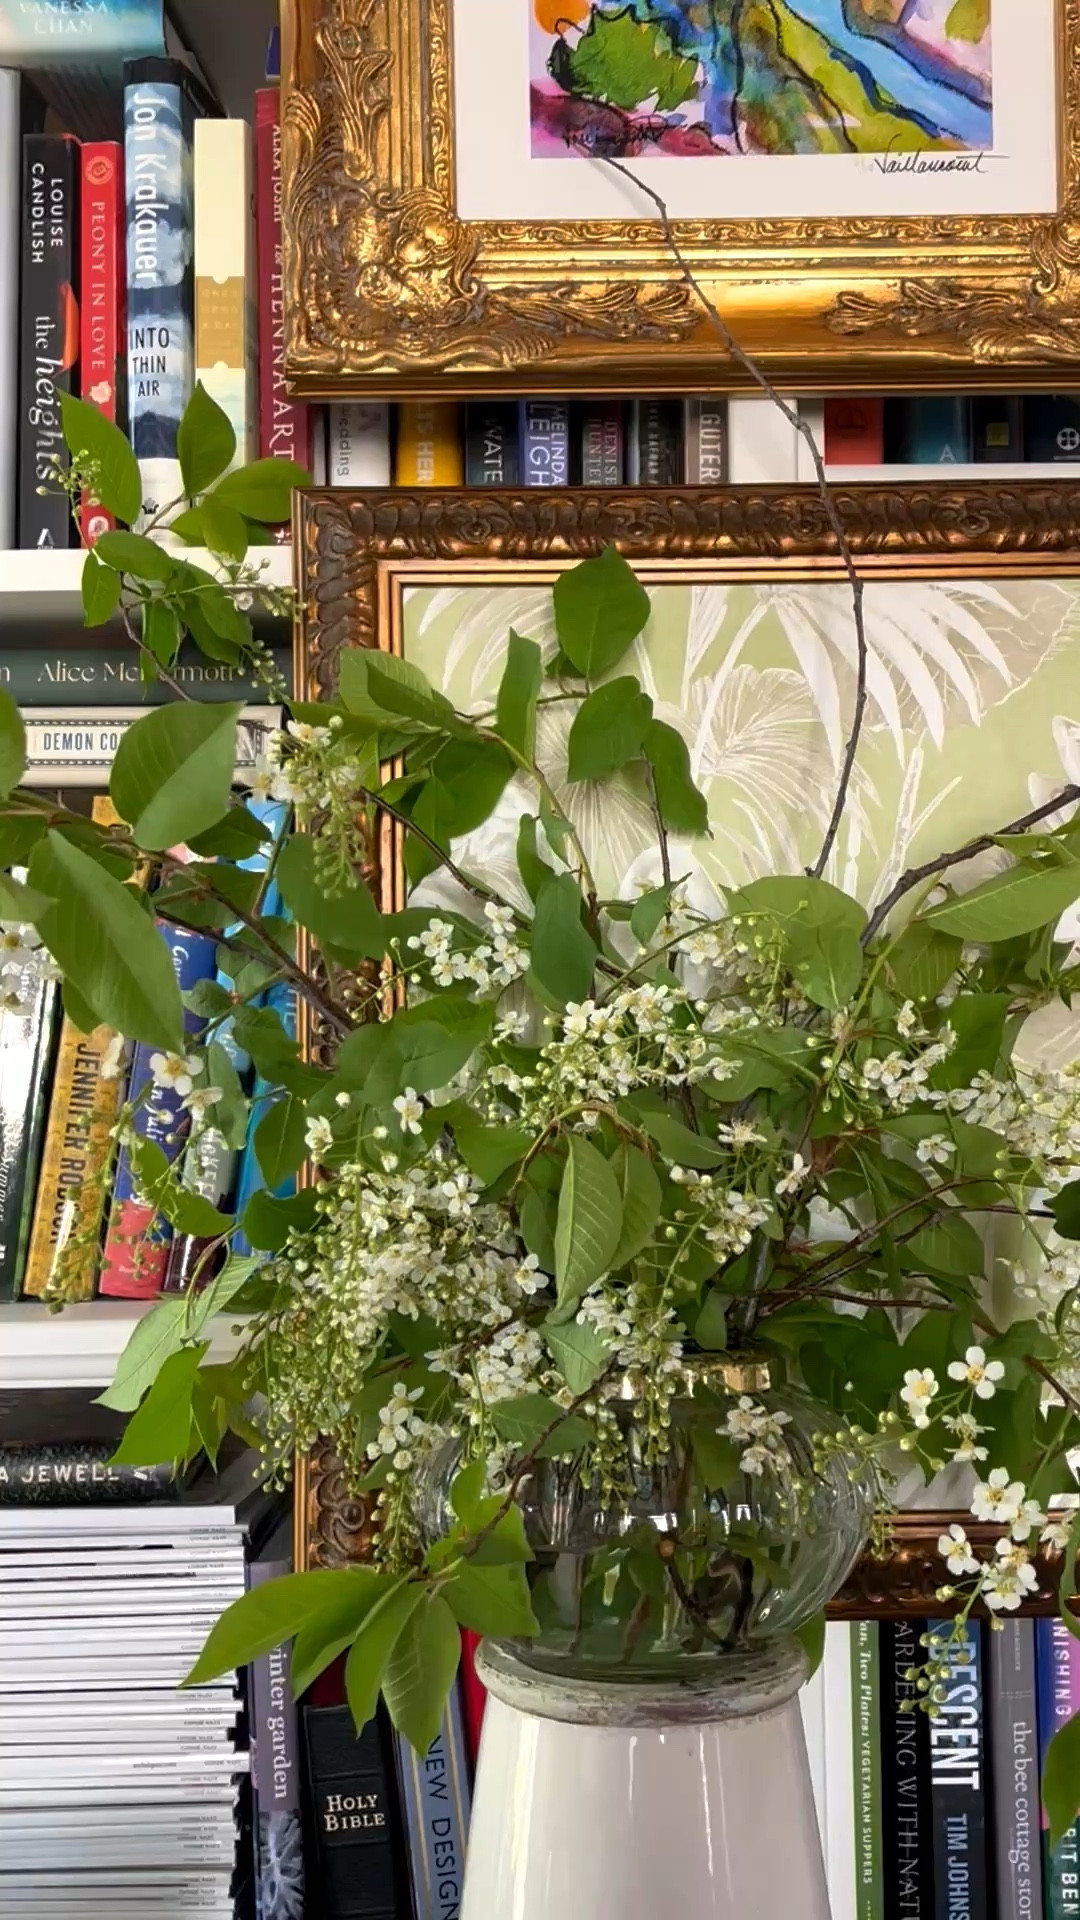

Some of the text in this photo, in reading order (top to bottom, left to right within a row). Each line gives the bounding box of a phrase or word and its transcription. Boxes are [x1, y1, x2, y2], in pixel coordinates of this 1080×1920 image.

[34, 19, 93, 34] CHAN
[133, 92, 169, 283] Jon Krakauer
[31, 162, 45, 263] CANDLISH
[50, 177, 64, 247] LOUISE
[91, 201, 106, 369] PEONY IN LOVE
[130, 327, 170, 350] INTO
[132, 356, 166, 375] THIN
[28, 316, 64, 480] the heights
[138, 380, 160, 397] AIR
[529, 404, 550, 486] LEIGH
[700, 414, 721, 484] GUTER
[37, 660, 97, 683] Alice
[43, 732, 94, 752] DEMON
[22, 1463, 119, 1484] JEWELL
[859, 1620, 872, 1644] an,
[860, 1650, 872, 1681] Two
[928, 1642, 979, 1790] DESCENT
[268, 1717, 291, 1799] garden
[1013, 1721, 1031, 1754] the
[425, 1736, 449, 1801] NEW
[861, 1738, 873, 1822] VEGETARIAN
[1015, 1758, 1032, 1793] bee
[325, 1813, 385, 1832] BIBLE
[326, 1794, 378, 1813] HOLY
[897, 1776, 918, 1848] WITH
[946, 1813, 967, 1850] TIM
[1009, 1797, 1031, 1873] cottage
[862, 1827, 873, 1884] SUPPERS
[1062, 1873, 1079, 1914] BEN
